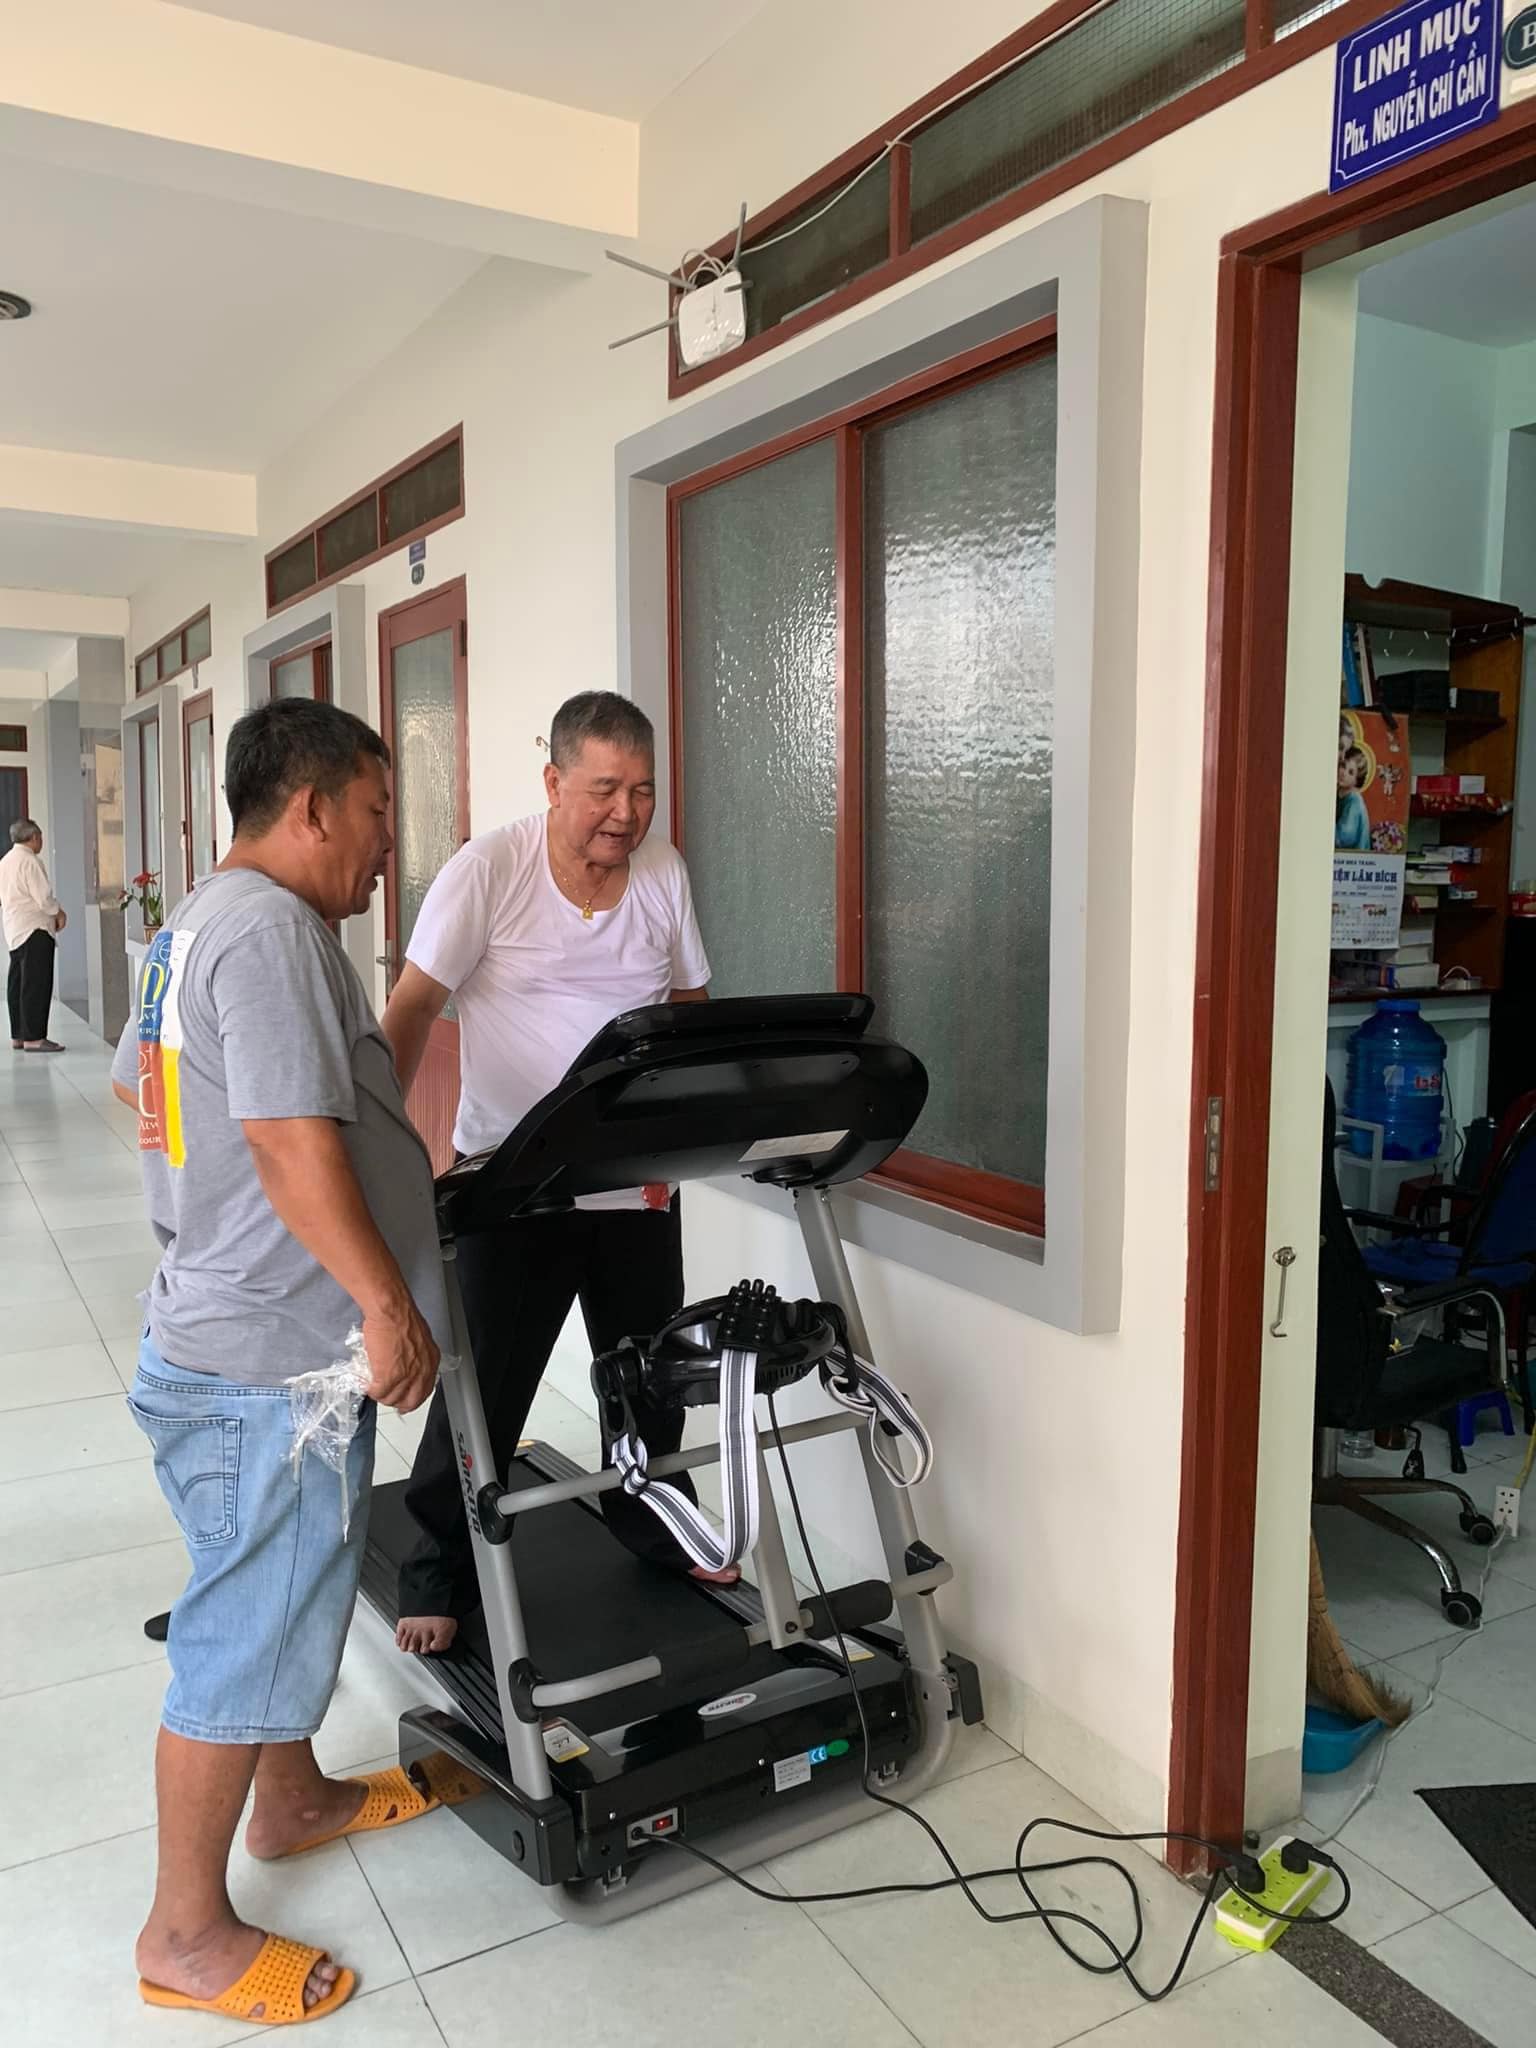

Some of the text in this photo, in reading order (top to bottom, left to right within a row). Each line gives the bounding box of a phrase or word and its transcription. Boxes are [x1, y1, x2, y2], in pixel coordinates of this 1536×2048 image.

[1353, 0, 1481, 93] LINH MỤC
[1343, 118, 1369, 160] Phx.
[1429, 59, 1455, 119] CHÍ
